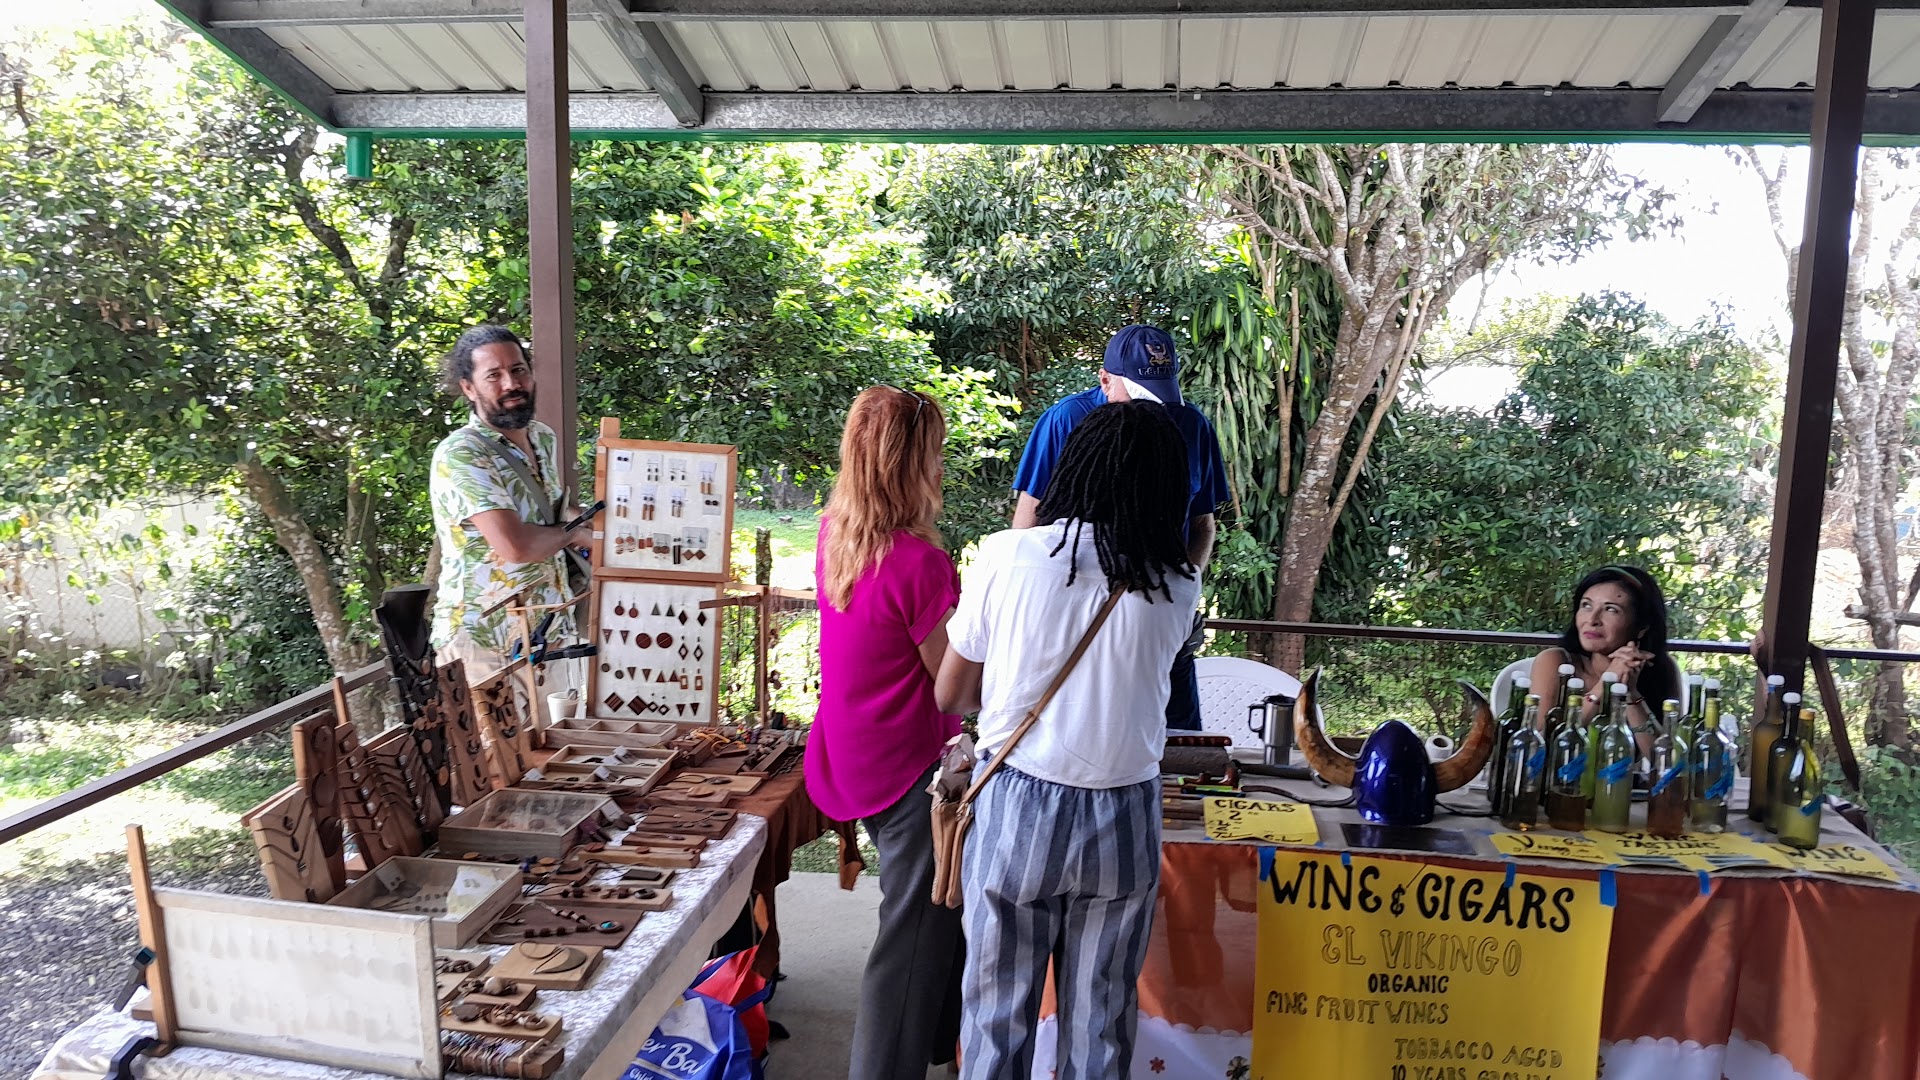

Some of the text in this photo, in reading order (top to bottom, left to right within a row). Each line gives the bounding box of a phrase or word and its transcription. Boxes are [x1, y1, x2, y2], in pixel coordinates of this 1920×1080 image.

[1214, 799, 1296, 813] CIGARS
[1269, 858, 1575, 933] WINE & CIGARS
[1321, 924, 1522, 977] EL VIKINGO
[1368, 973, 1450, 994] ORGANIC
[1266, 990, 1450, 1025] FINE FRUIT WINES
[1394, 1037, 1563, 1068] TOBBACCO AGED
[1391, 1064, 1407, 1080] 10
[1413, 1066, 1467, 1080] YEARS
